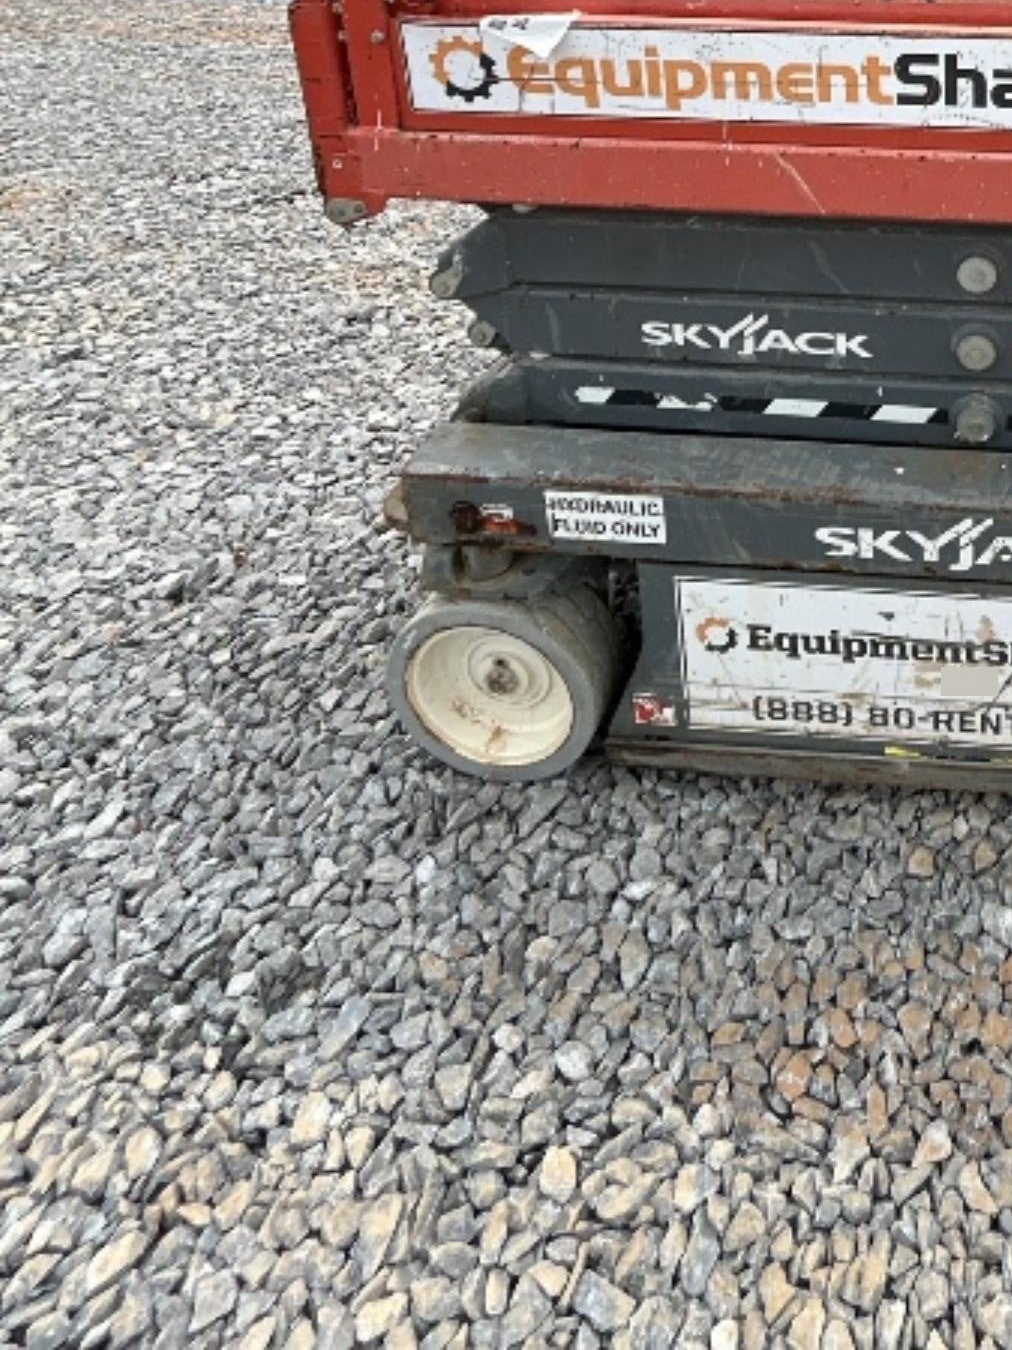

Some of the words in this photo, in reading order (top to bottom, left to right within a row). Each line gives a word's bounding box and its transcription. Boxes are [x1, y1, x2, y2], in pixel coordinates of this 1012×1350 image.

[640, 313, 874, 358] SKYJACK
[611, 521, 661, 538] ONLY
[752, 695, 854, 726] (888)
